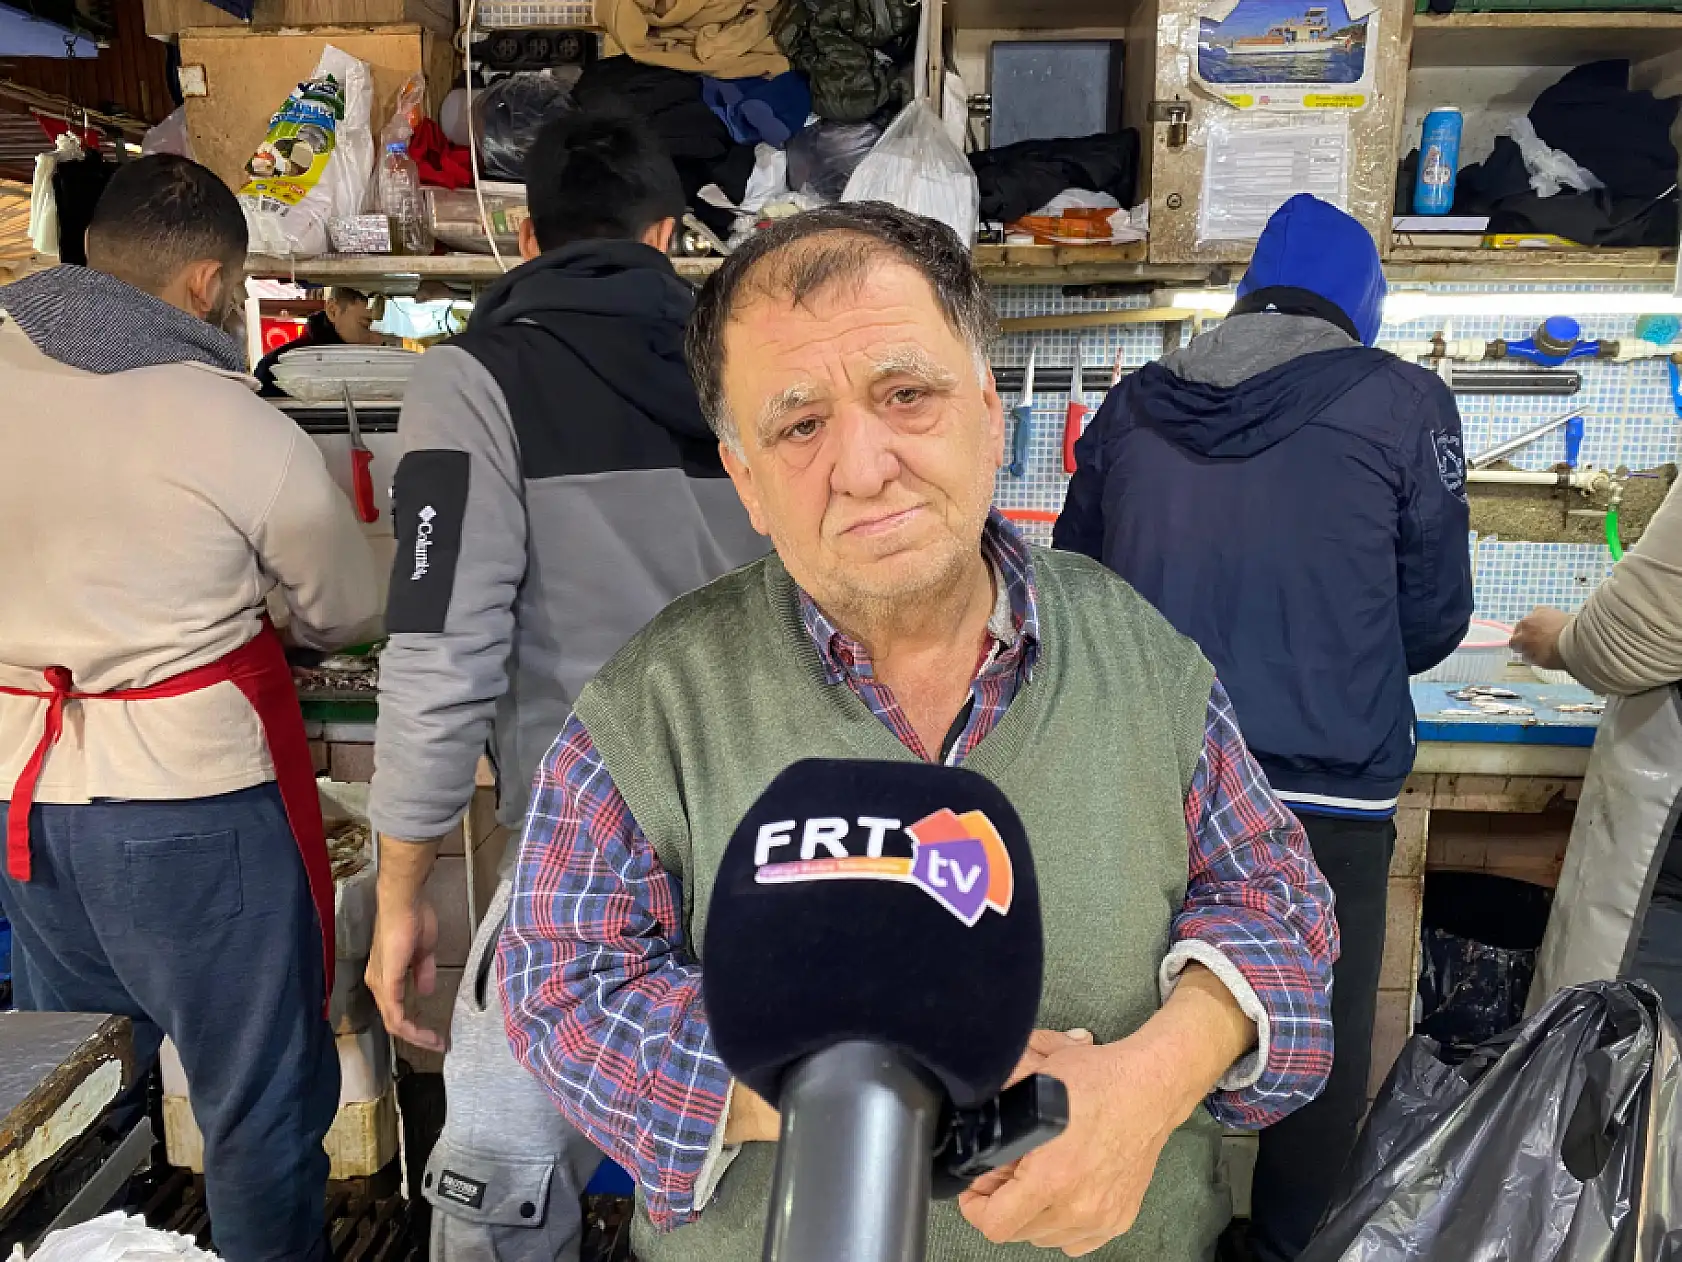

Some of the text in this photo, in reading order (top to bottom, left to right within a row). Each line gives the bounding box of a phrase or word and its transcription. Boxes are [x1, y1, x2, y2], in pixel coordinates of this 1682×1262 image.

[410, 523, 433, 580] Columbia
[755, 817, 901, 865] FRT
[927, 849, 982, 893] tv
